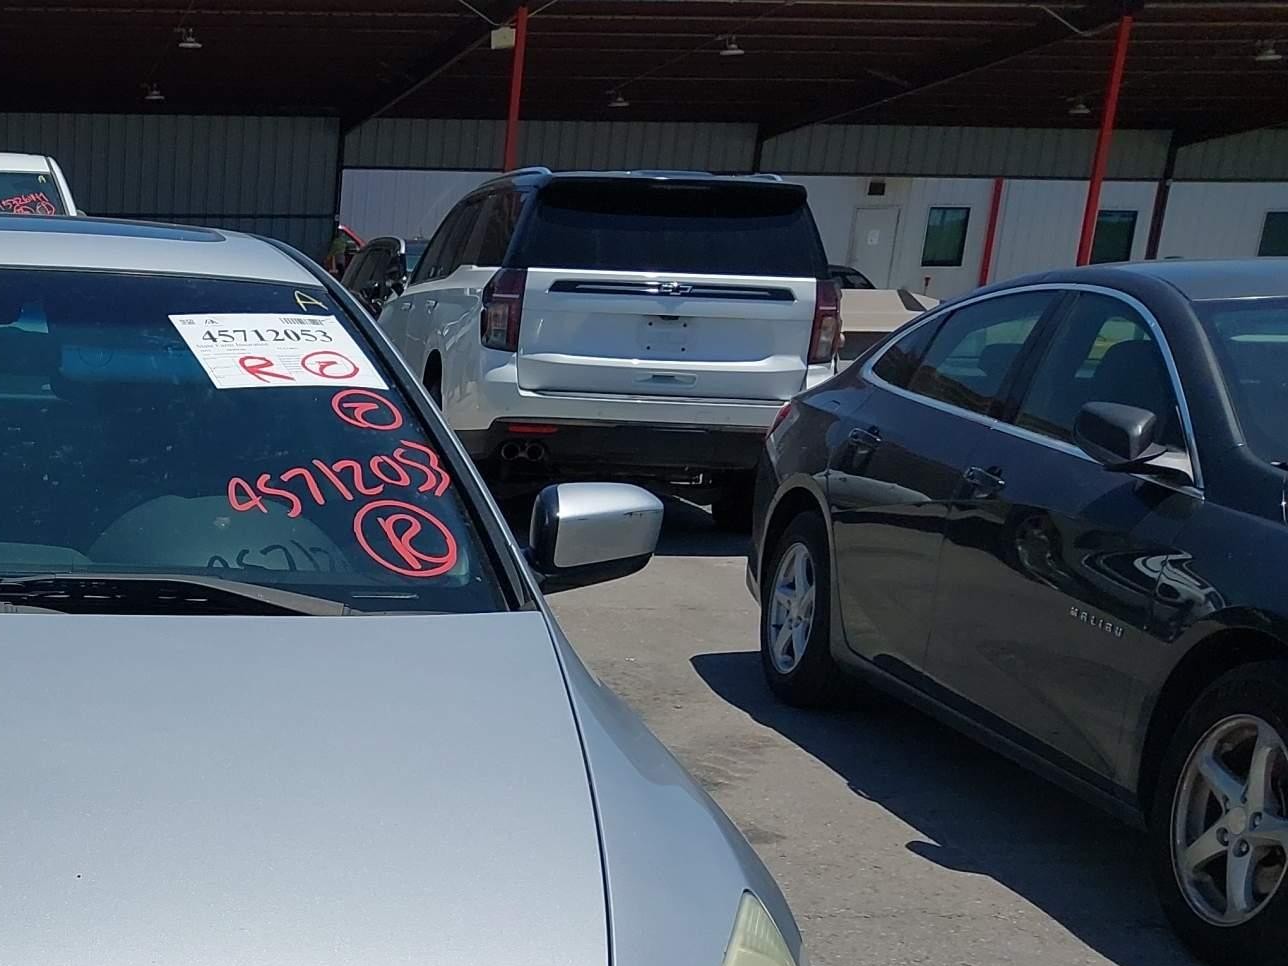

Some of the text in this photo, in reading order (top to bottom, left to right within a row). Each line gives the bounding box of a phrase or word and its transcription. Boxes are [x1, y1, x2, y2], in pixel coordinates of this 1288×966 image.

[294, 290, 329, 312] A
[201, 328, 334, 343] 45712053
[238, 355, 297, 384] R
[227, 439, 451, 518] 45712053
[372, 508, 452, 572] R
